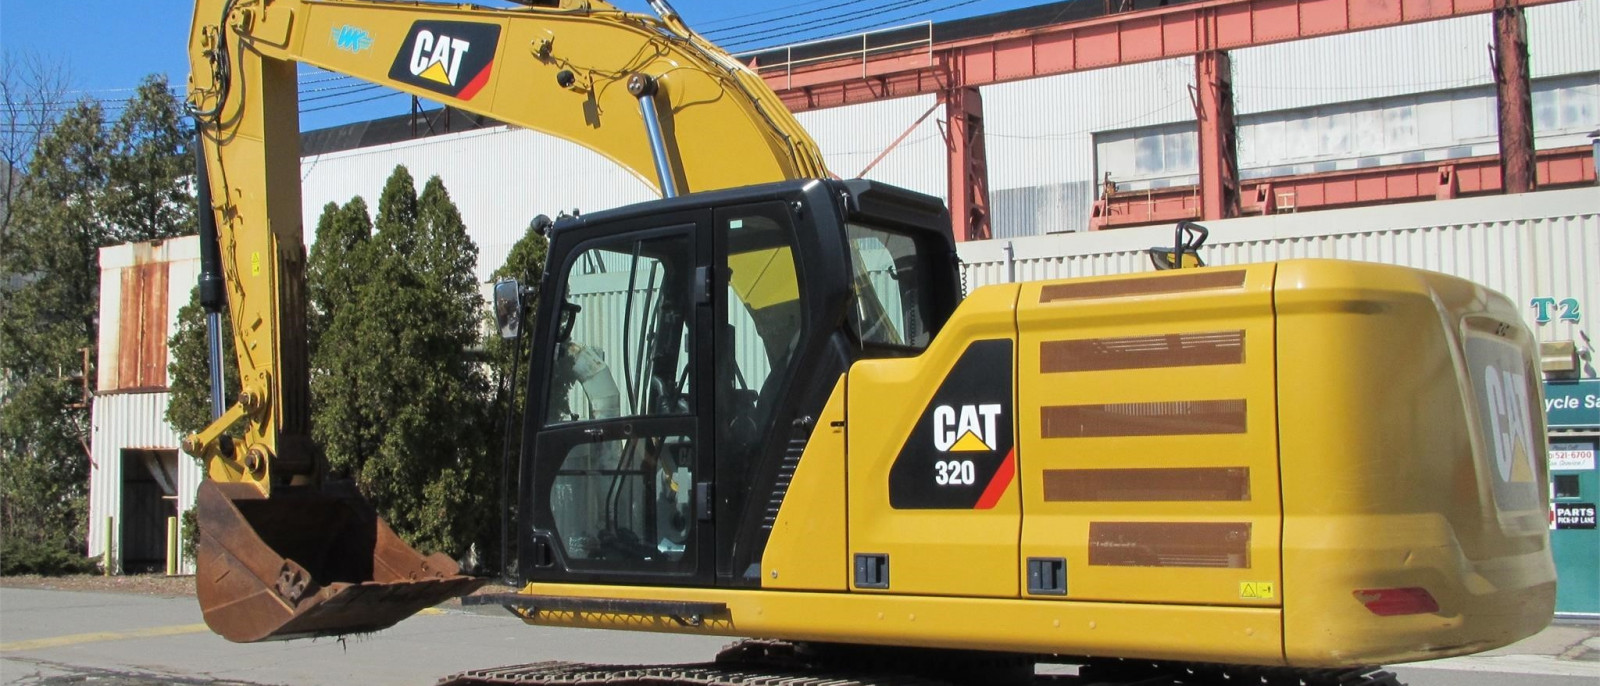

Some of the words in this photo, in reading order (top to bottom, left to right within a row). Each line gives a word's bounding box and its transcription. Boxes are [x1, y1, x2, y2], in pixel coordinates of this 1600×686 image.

[409, 29, 470, 87] CAT
[1529, 296, 1581, 322] T2
[933, 403, 1002, 452] CAT
[1485, 365, 1537, 482] CAT
[935, 460, 975, 485] 320
[1557, 508, 1595, 517] PARTS
